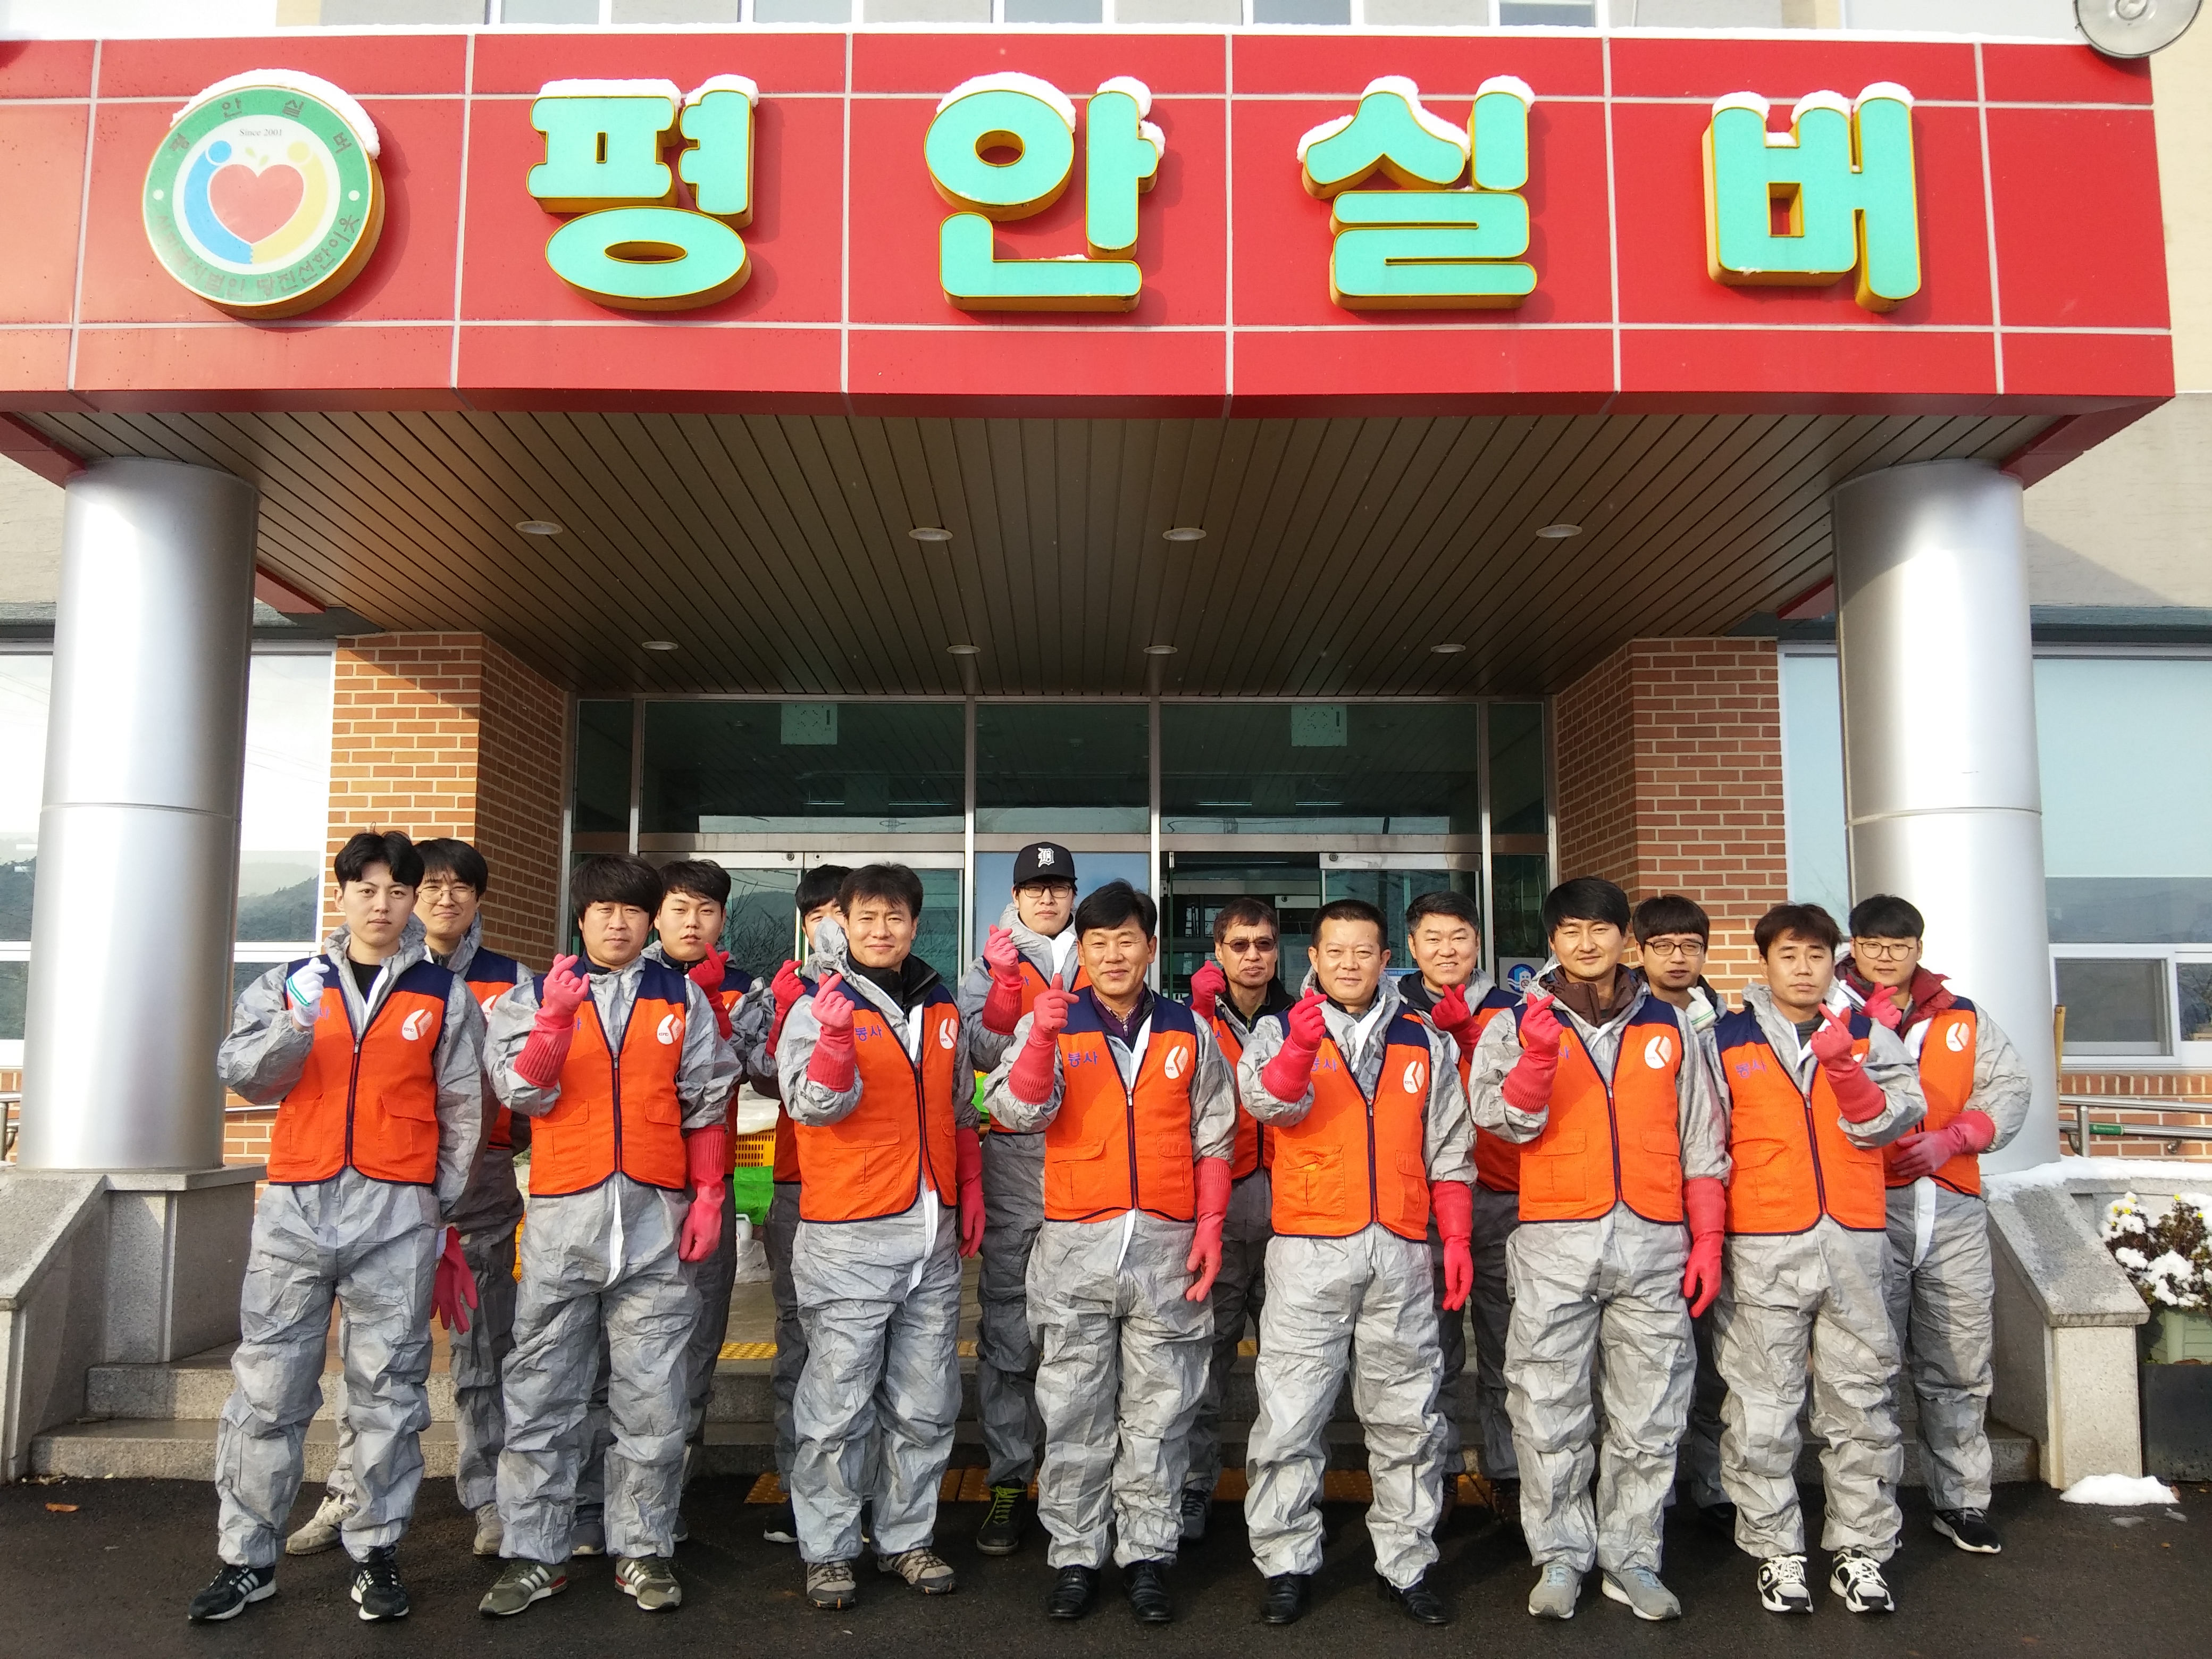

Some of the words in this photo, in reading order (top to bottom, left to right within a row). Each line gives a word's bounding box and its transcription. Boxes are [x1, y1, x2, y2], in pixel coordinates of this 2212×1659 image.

[526, 80, 1922, 313] 평안실버
[855, 1025, 881, 1041] 봉사
[1067, 1051, 1097, 1068] 봉사
[1735, 1059, 1766, 1078] 봉사
